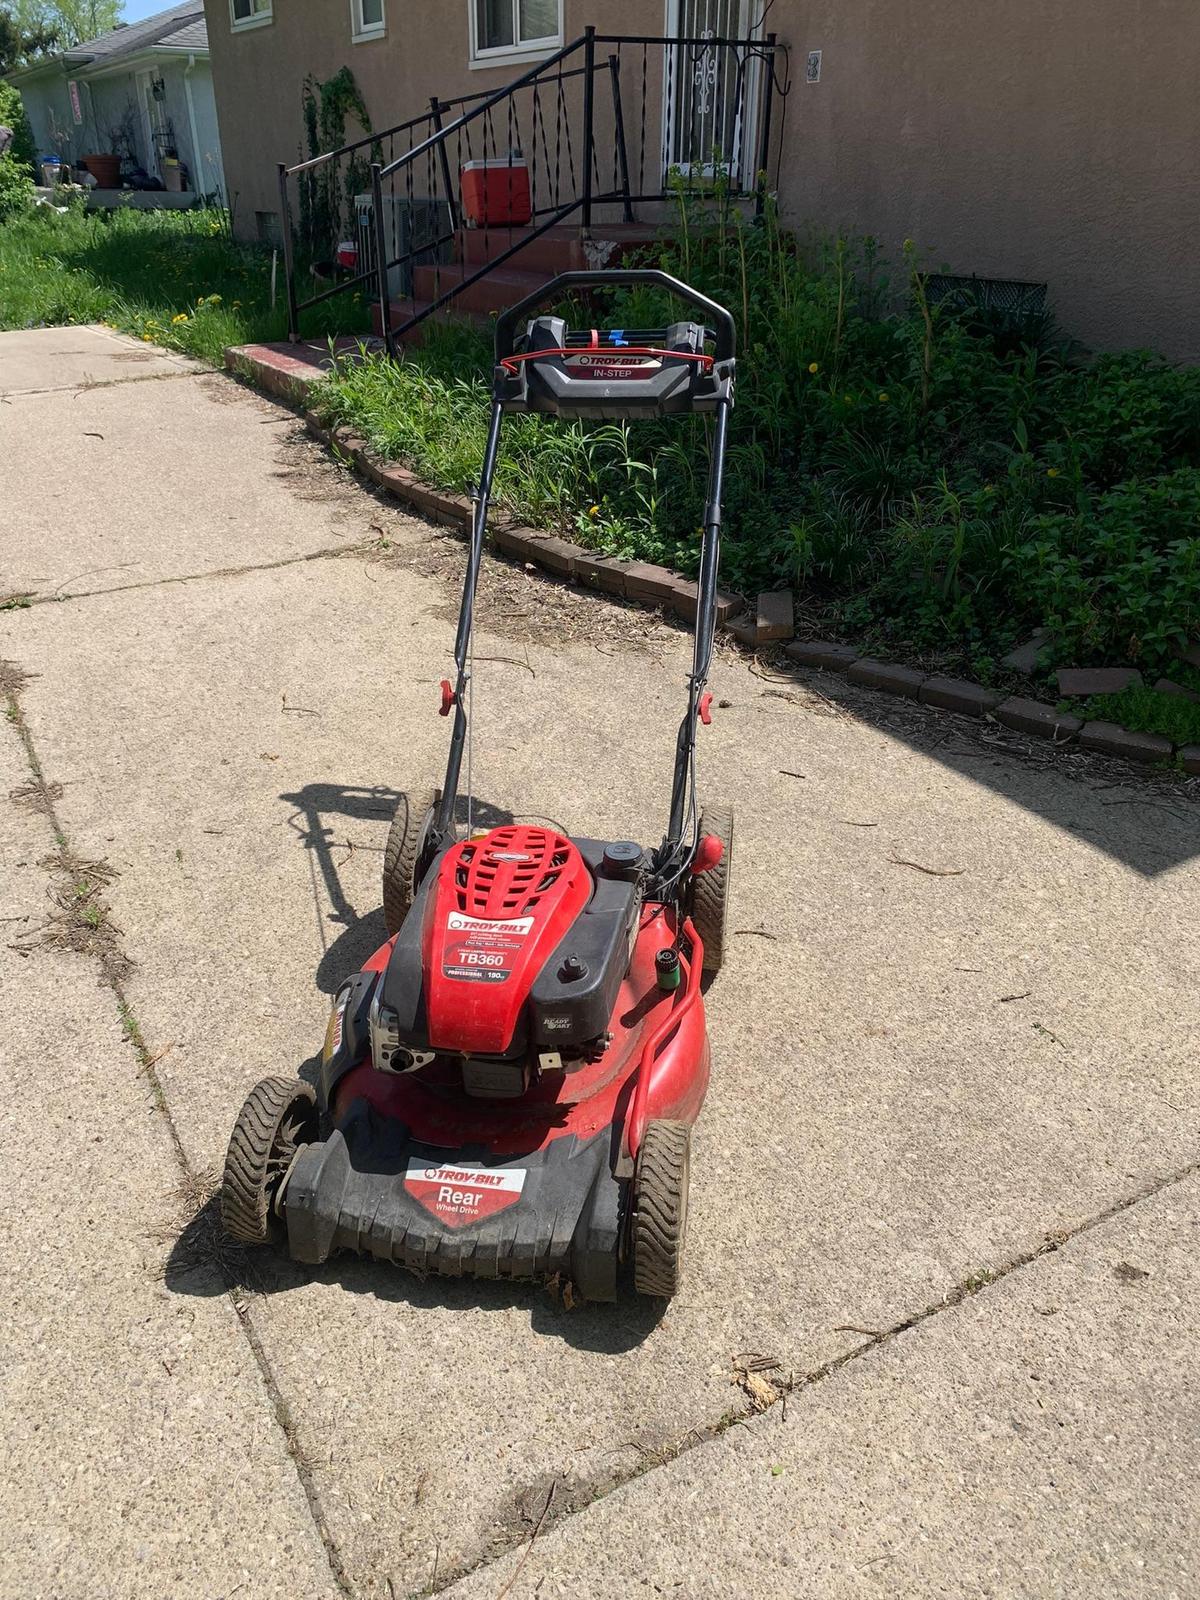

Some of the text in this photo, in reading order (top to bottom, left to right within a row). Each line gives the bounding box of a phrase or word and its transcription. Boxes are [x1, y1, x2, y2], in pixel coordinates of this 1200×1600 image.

[590, 357, 644, 365] TROY-BILT
[593, 369, 632, 378] IN-STEP
[463, 920, 528, 933] TROY-BILT
[459, 953, 504, 966] TB360
[437, 1169, 505, 1186] TROY-BILT
[438, 1187, 483, 1206] Rear
[436, 1203, 479, 1215] Wheel Drive
